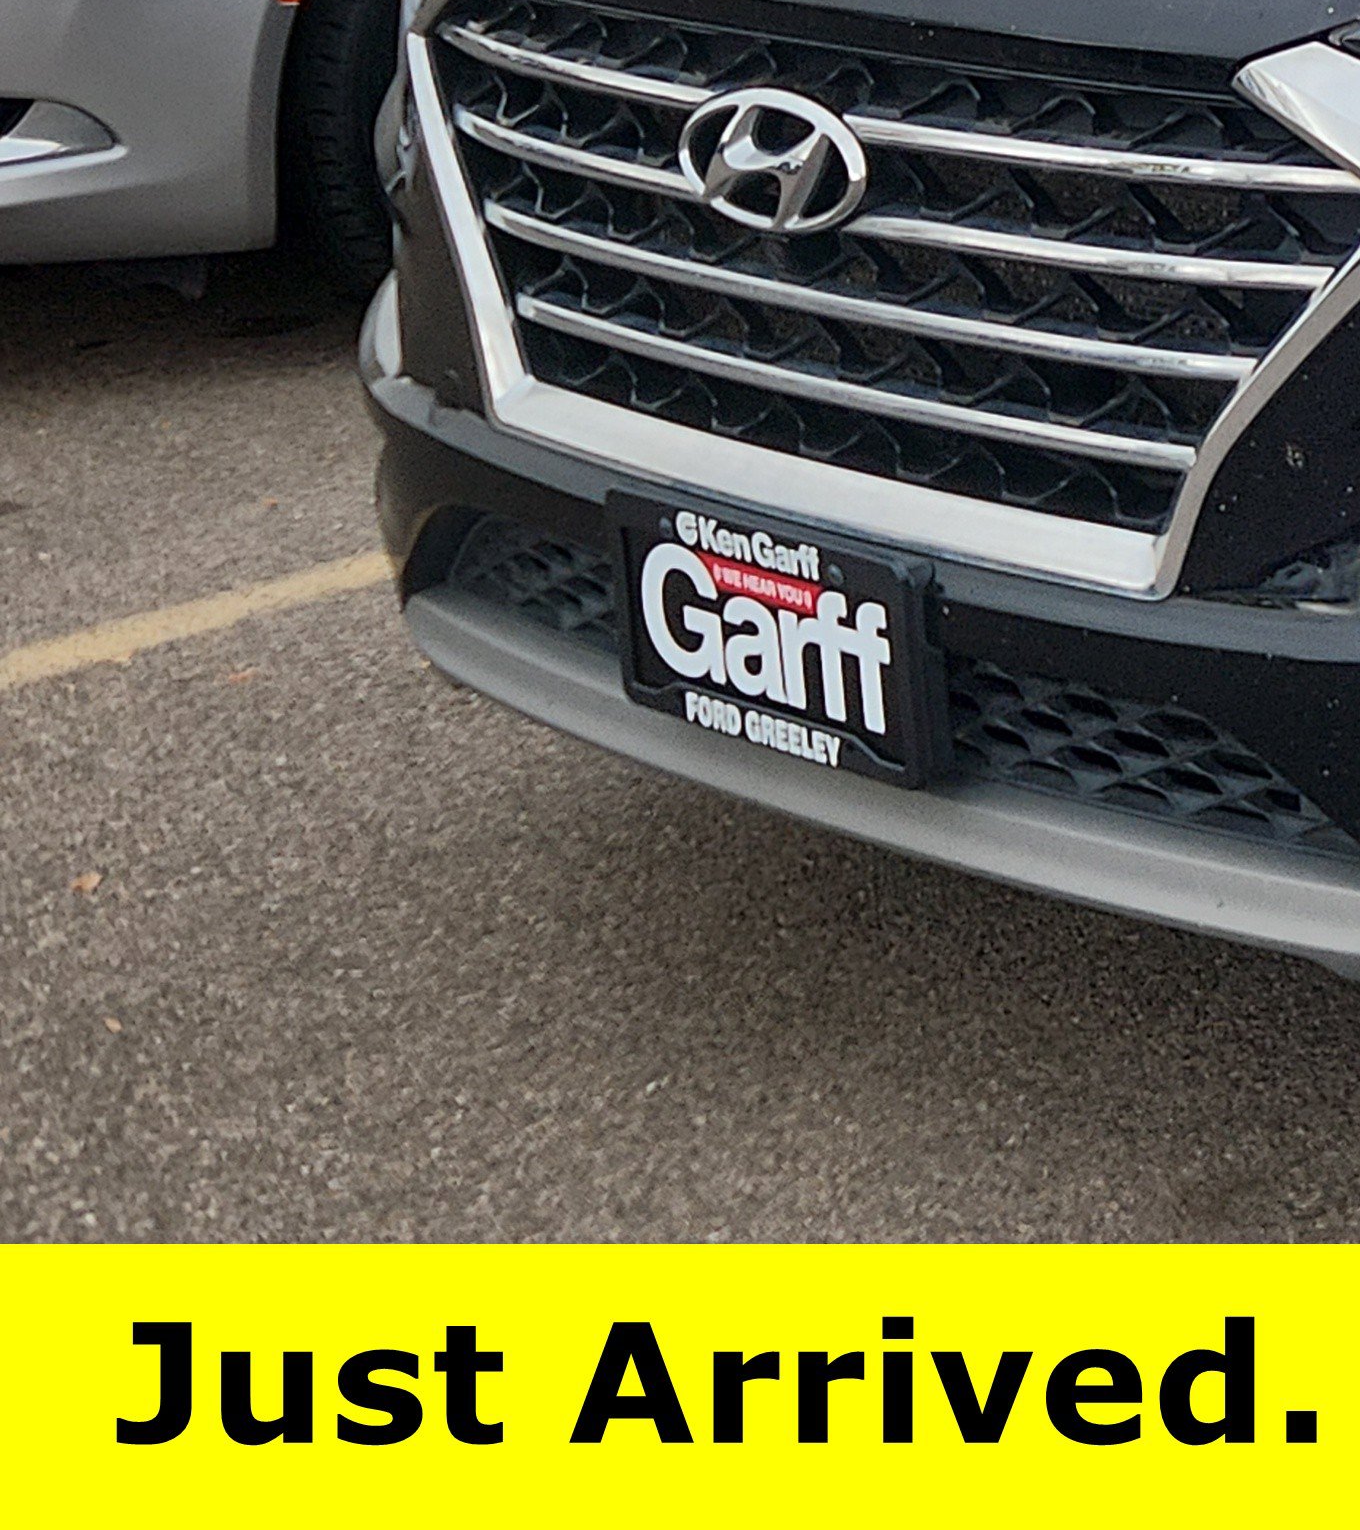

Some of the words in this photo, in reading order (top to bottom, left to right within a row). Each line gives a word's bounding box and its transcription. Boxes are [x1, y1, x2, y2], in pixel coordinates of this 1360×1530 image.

[641, 542, 891, 735] Garff
[685, 691, 742, 736] FORD
[745, 710, 840, 768] GREELEY
